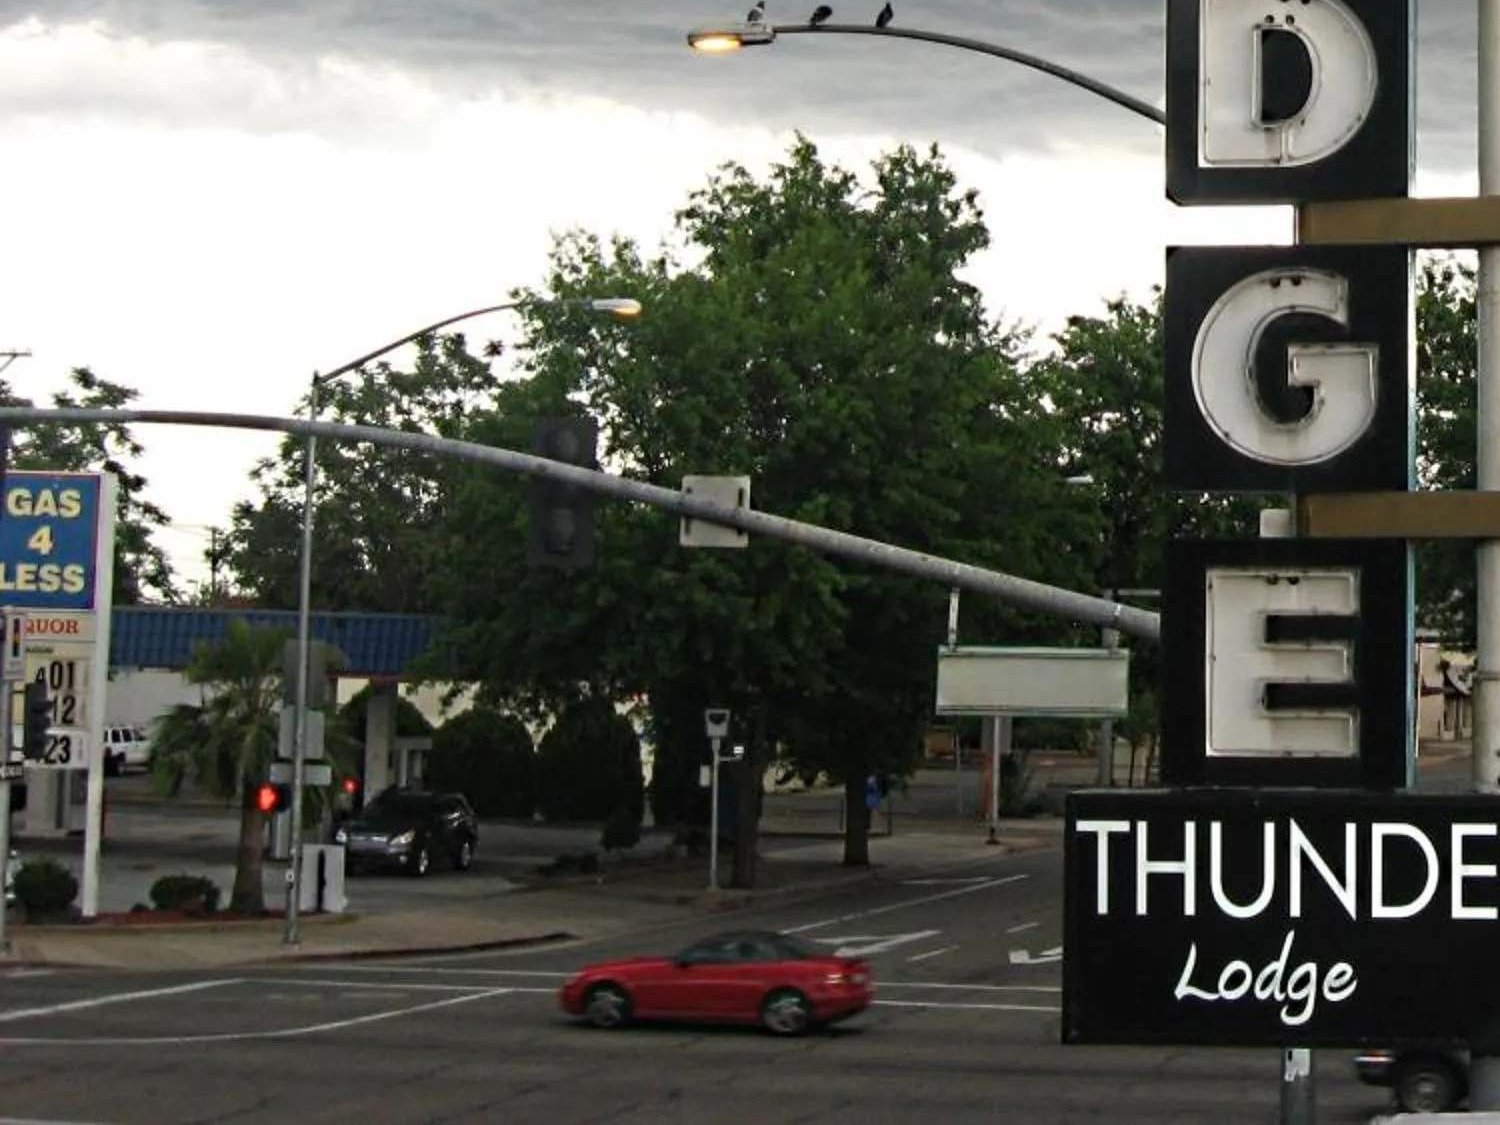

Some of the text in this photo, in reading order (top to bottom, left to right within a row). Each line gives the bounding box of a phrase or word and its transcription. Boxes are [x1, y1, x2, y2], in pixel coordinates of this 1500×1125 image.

[7, 487, 82, 519] GAS
[27, 524, 54, 555] 4
[0, 561, 85, 594] LESS
[1175, 929, 1358, 1027] Lodge
